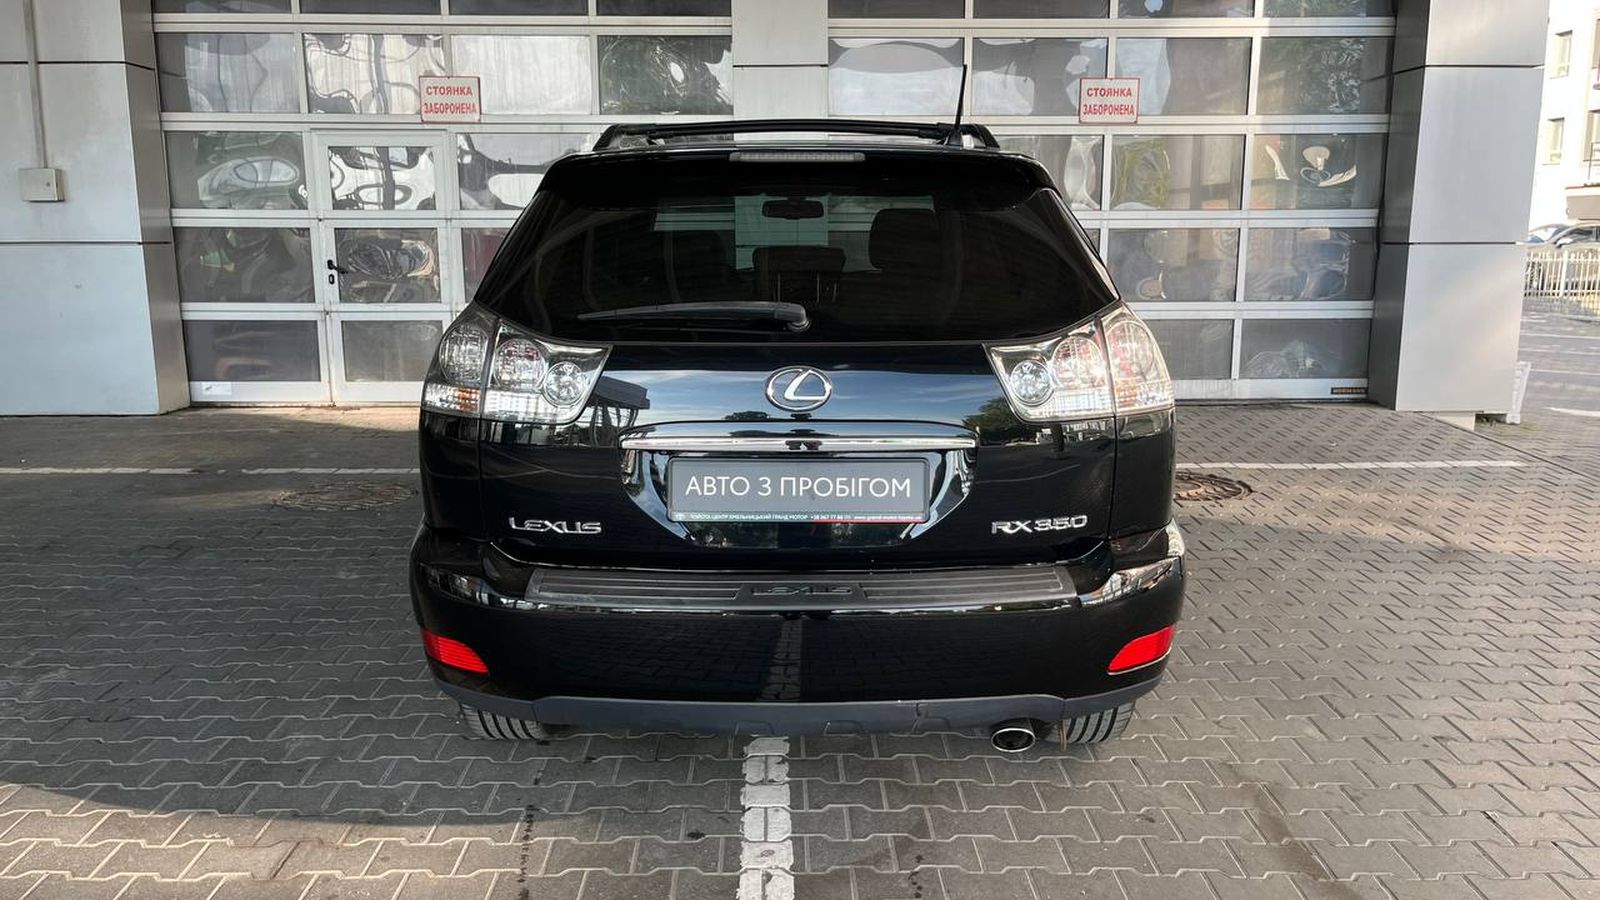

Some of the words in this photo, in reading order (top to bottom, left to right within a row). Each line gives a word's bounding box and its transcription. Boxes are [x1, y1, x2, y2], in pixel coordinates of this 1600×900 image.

[426, 86, 473, 96] СТОЯНКА
[1086, 87, 1132, 97] СТОЯНКА
[424, 102, 477, 114] ЗАБОРОНЕНА
[1083, 104, 1135, 116] ЗАБОРОНЕНА
[685, 475, 751, 497] АВТО
[780, 476, 911, 498] ПРОБІГОМ
[509, 517, 602, 534] LEXUS
[991, 520, 1033, 534] RX
[1034, 515, 1088, 531] 350
[750, 586, 853, 596] LEXUS
